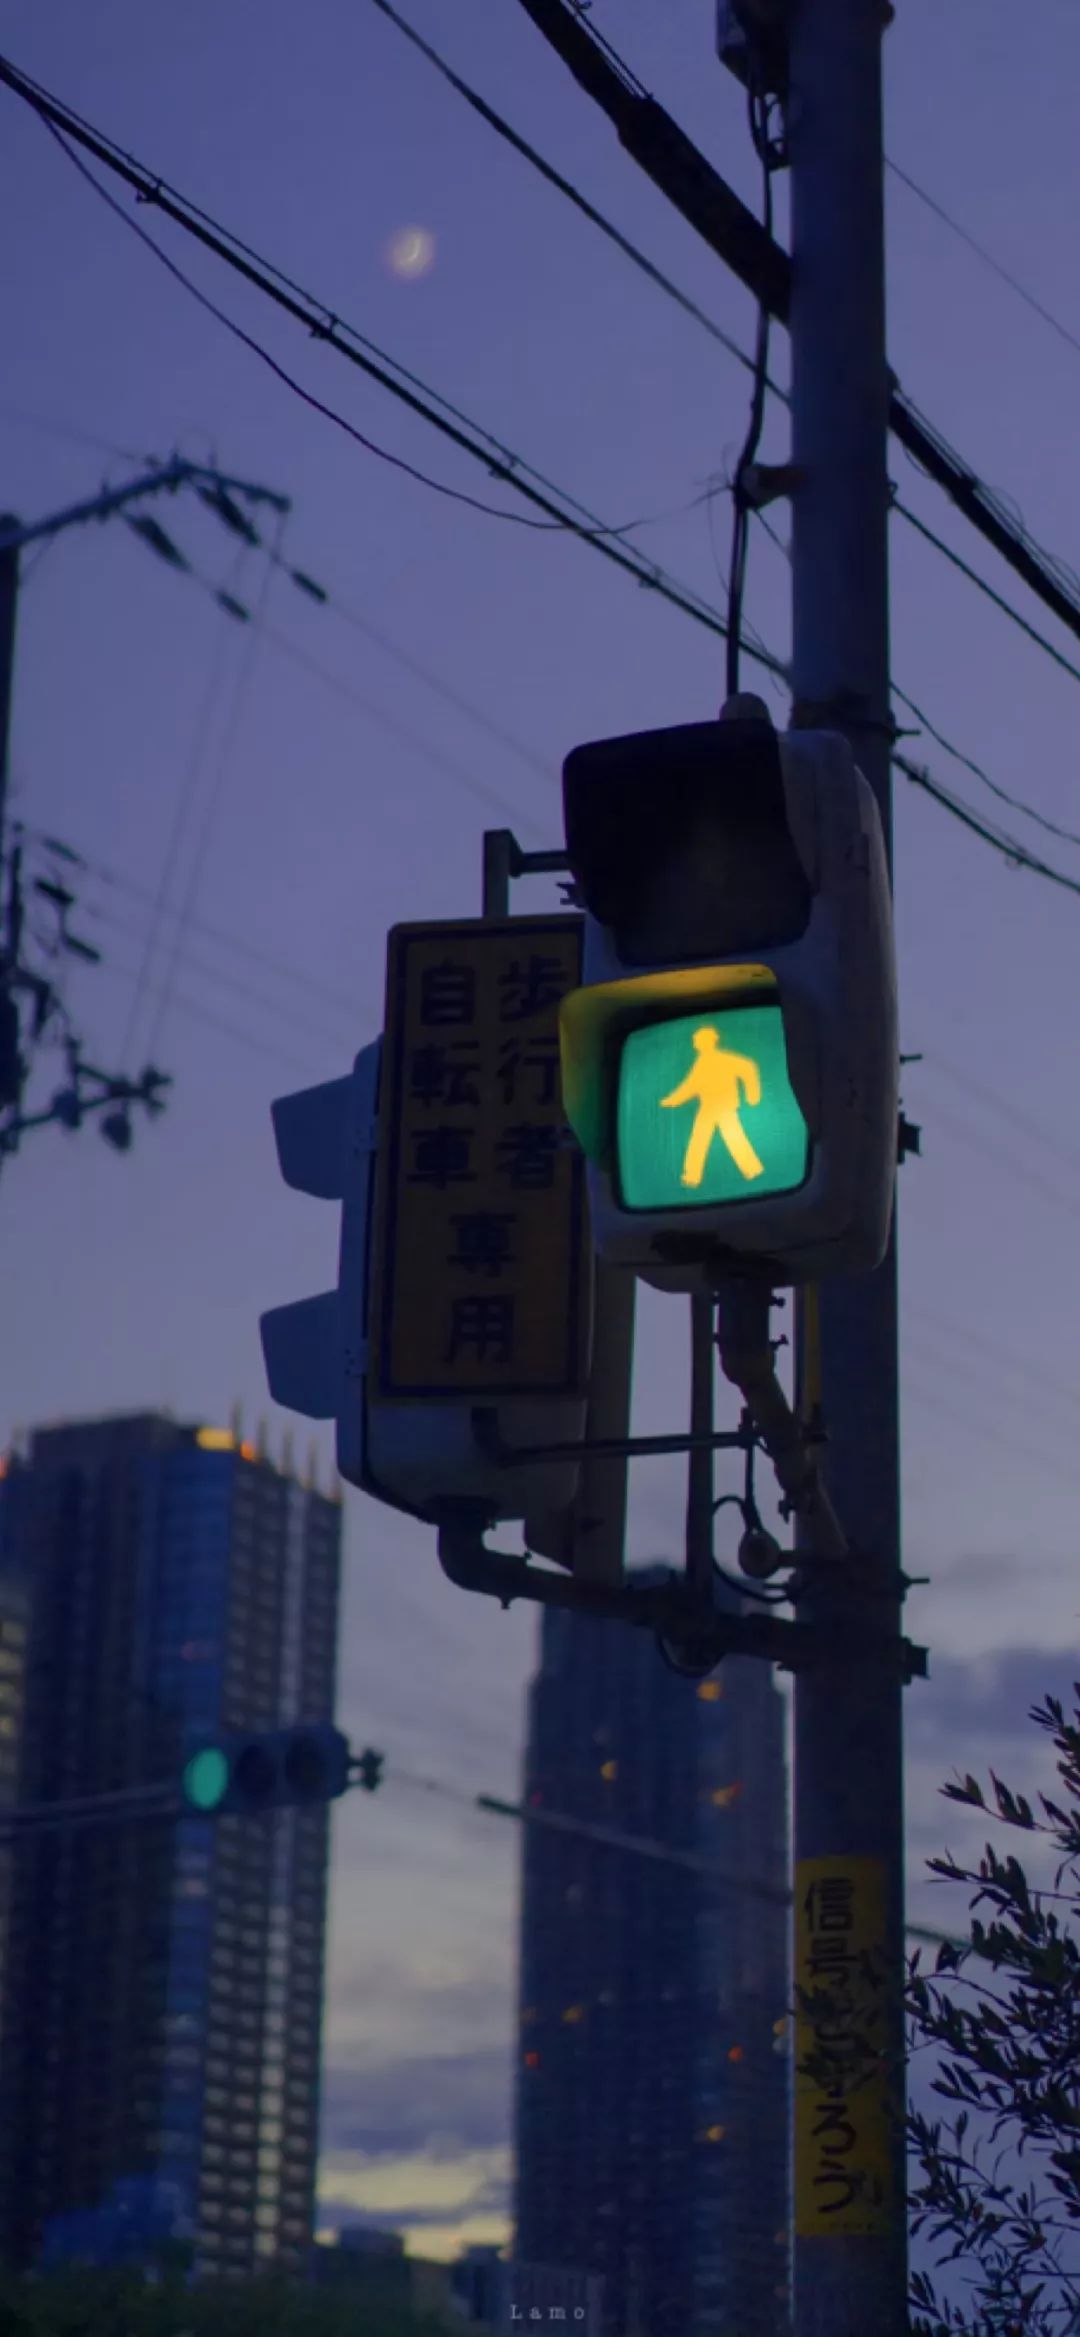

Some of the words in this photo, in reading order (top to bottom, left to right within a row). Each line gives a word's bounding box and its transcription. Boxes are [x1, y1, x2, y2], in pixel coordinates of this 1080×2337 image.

[407, 958, 481, 1190] 自転車
[495, 955, 568, 1190] 歩行者
[442, 1210, 518, 1364] 専用
